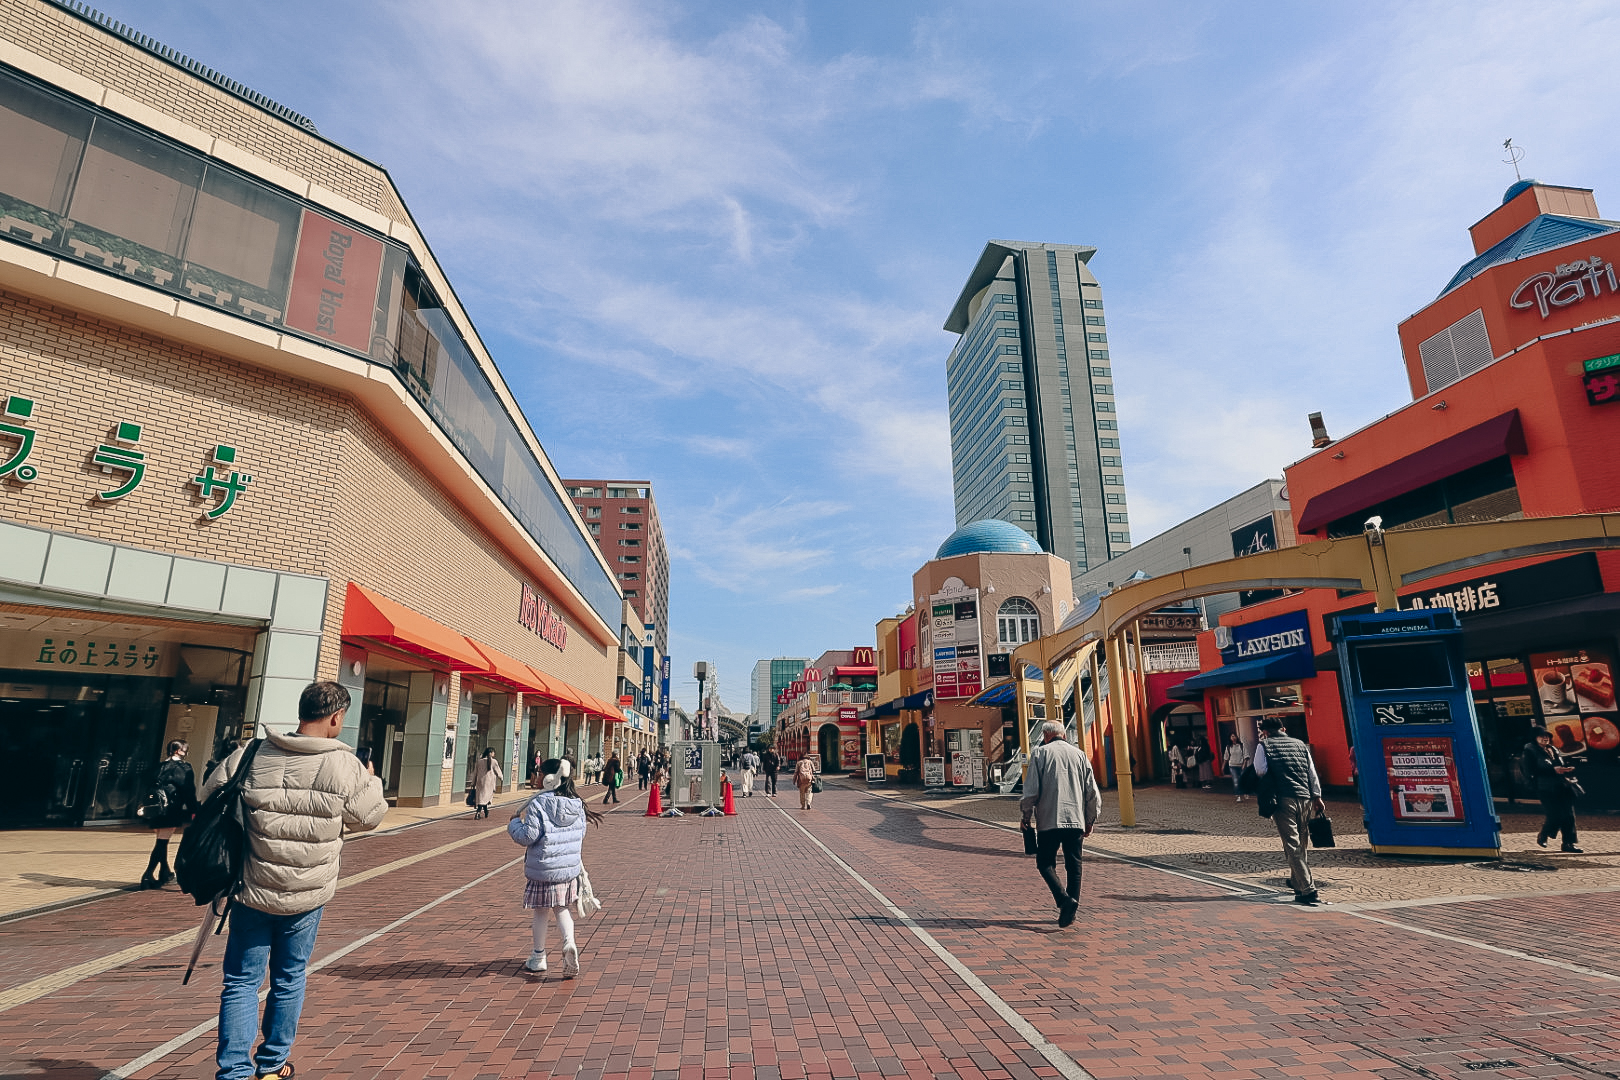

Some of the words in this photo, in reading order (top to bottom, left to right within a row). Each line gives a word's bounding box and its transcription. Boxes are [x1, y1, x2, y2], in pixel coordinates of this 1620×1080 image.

[321, 229, 353, 286] Royal
[1510, 262, 1620, 318] Pati
[314, 290, 346, 336] Host
[1374, 581, 1500, 613] ール珈琲店
[35, 644, 159, 670] 丘の上プラザ
[1236, 628, 1307, 658] LAWSON
